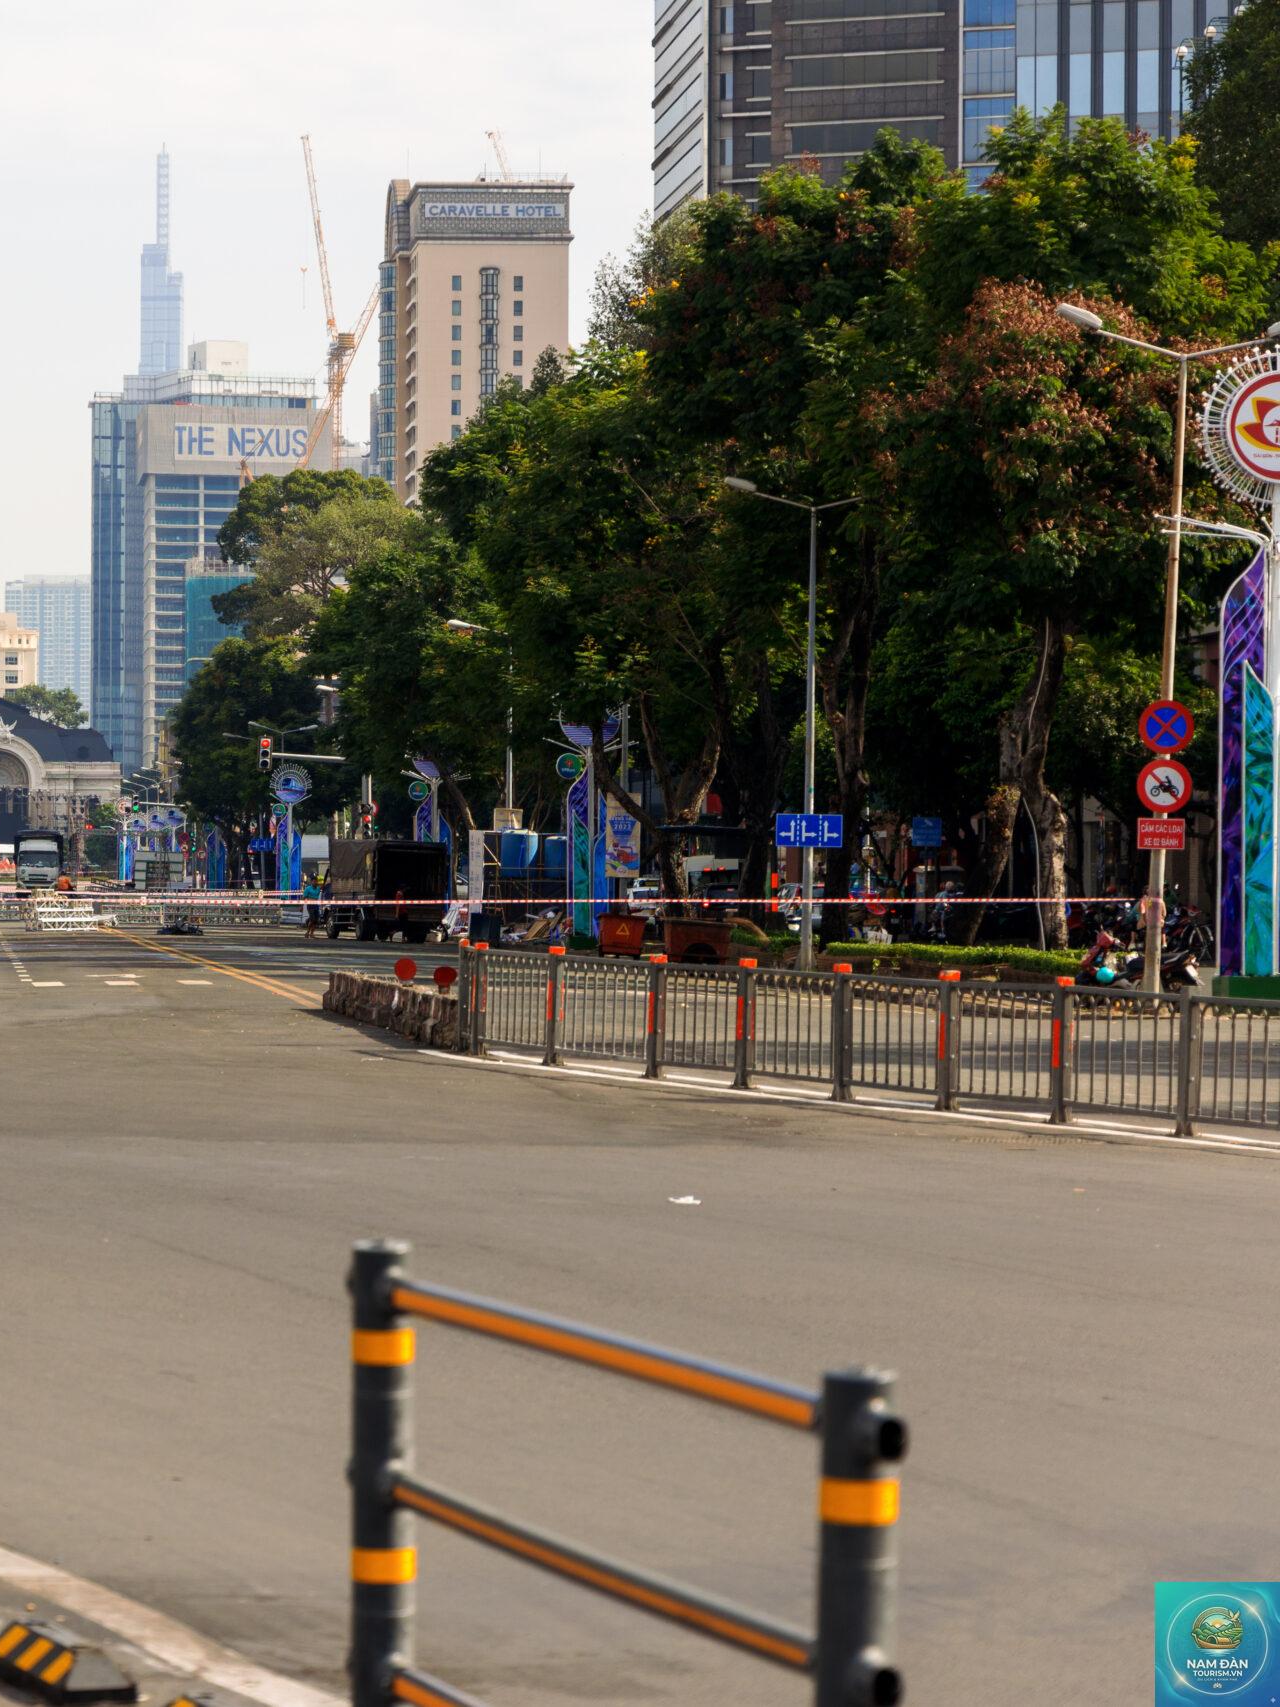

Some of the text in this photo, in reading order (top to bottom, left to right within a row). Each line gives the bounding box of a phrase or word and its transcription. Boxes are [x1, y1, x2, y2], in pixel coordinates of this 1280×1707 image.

[428, 205, 562, 217] CARAVELLE HOTEL
[175, 425, 308, 458] THE NEXUS
